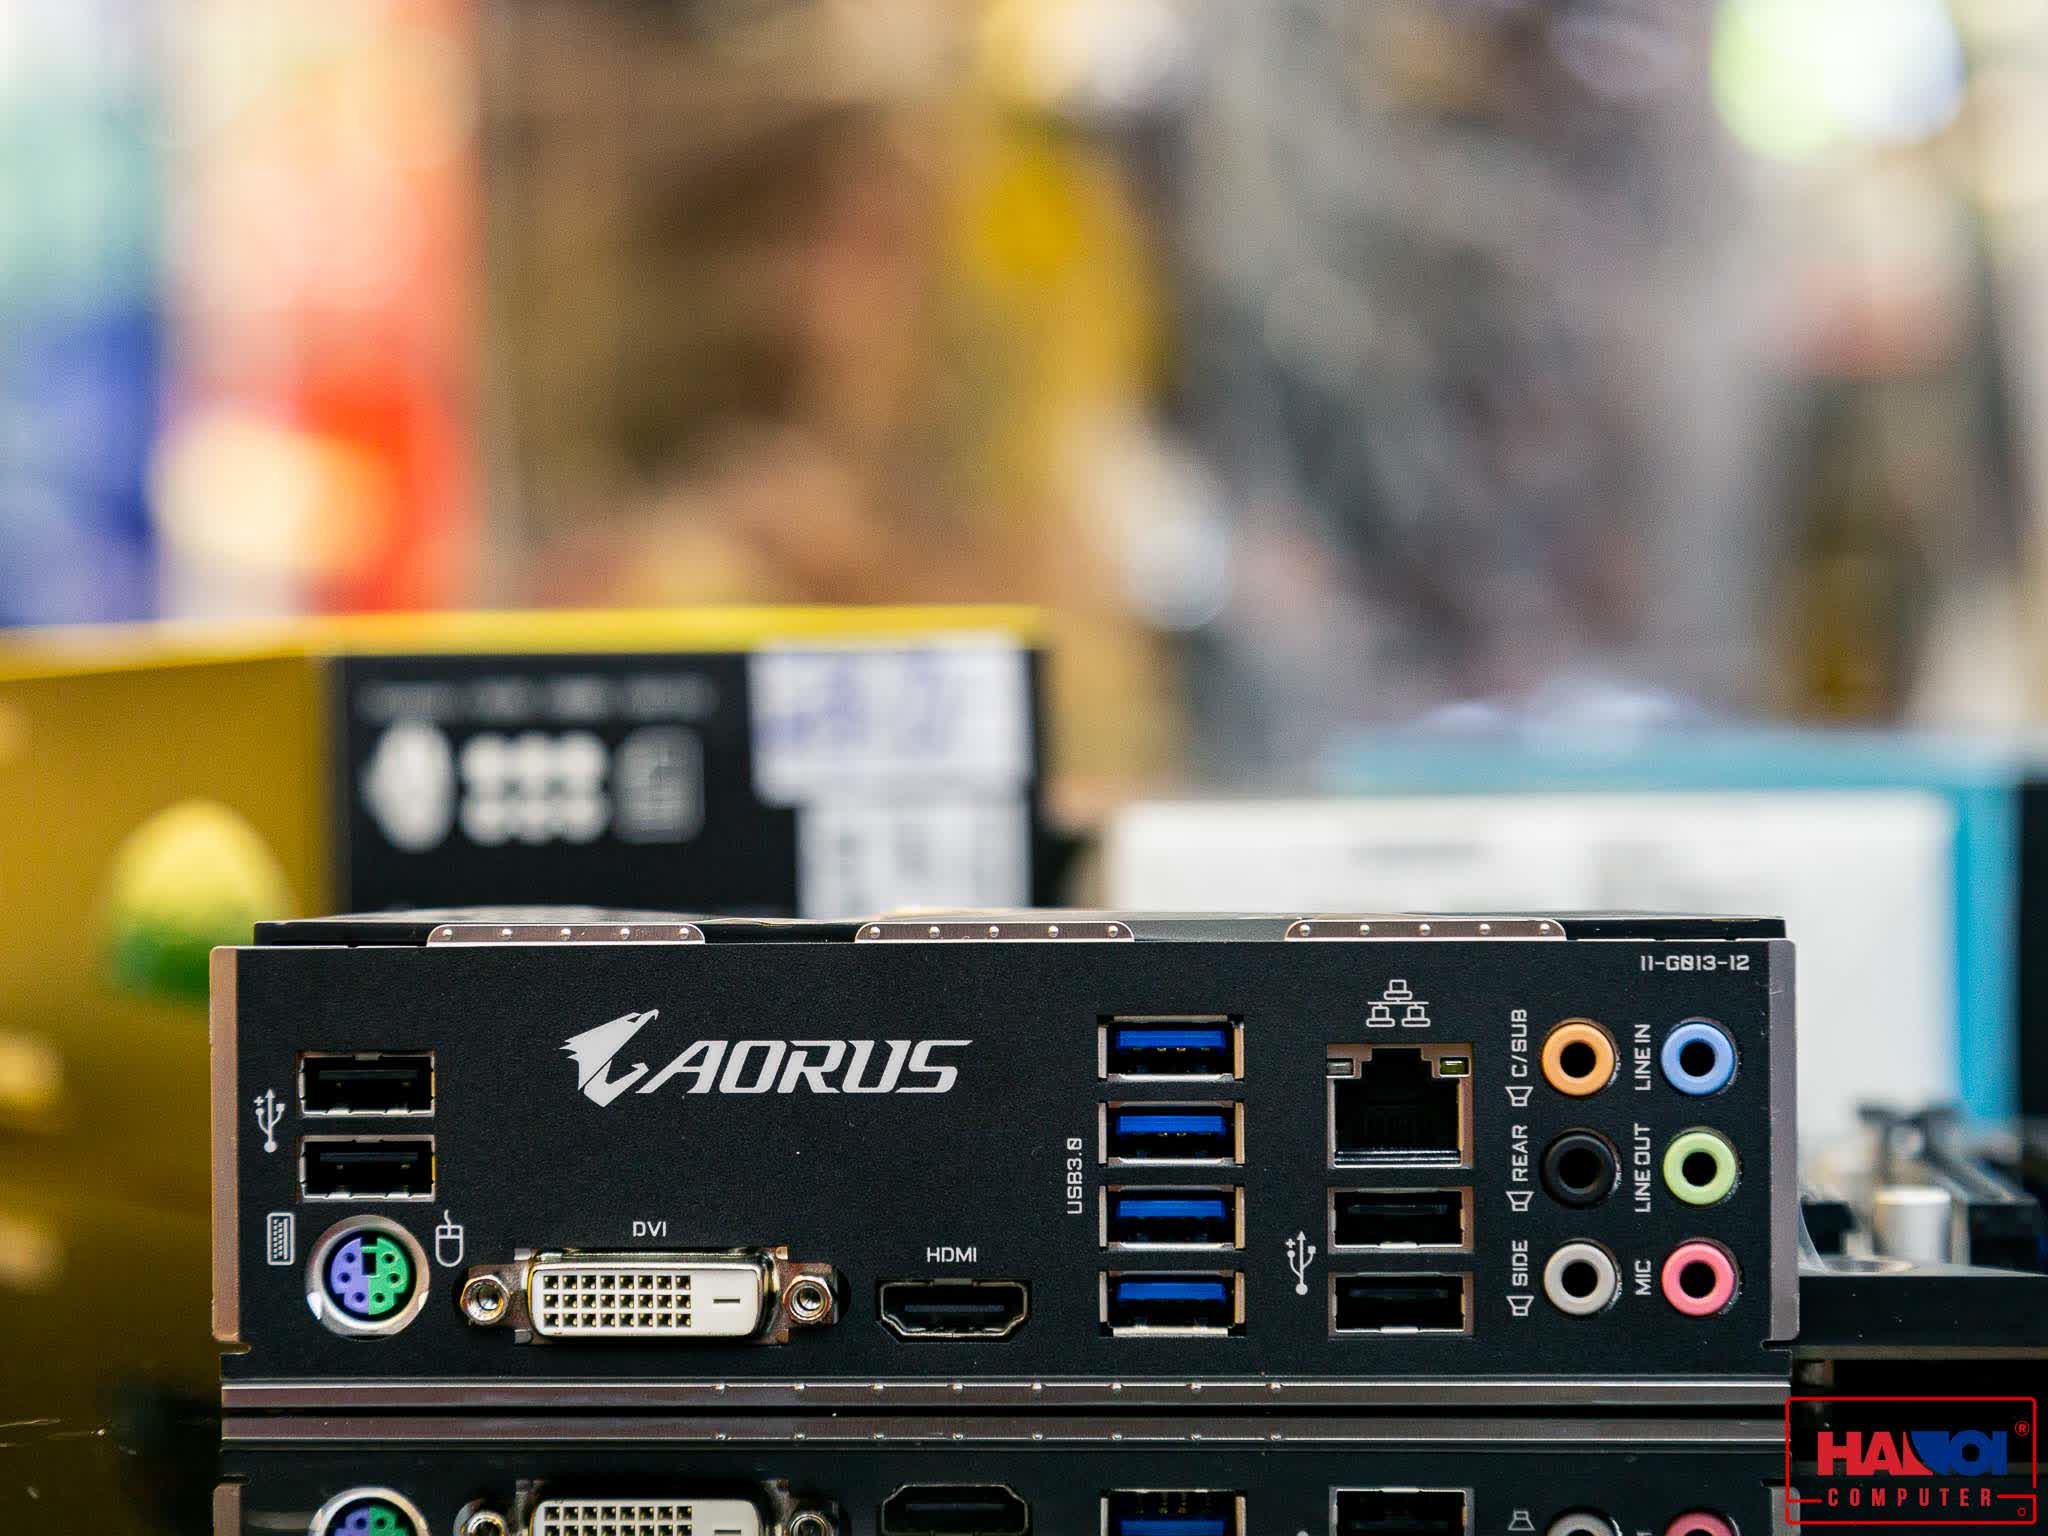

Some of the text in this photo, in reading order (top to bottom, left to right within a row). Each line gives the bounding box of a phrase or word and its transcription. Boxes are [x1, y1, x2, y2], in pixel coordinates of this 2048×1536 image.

[634, 1039, 973, 1094] AORUS
[1510, 1008, 1528, 1078] C/SUB
[1633, 1023, 1652, 1091] LINE IN
[1066, 1137, 1083, 1215] USB3.0
[1511, 1124, 1529, 1182] REAR
[1633, 1122, 1652, 1213] LINE OUT
[632, 1220, 667, 1238] DVI
[926, 1246, 977, 1263] HDMI
[1511, 1239, 1529, 1287] SIDE
[1634, 1259, 1652, 1296] MIC
